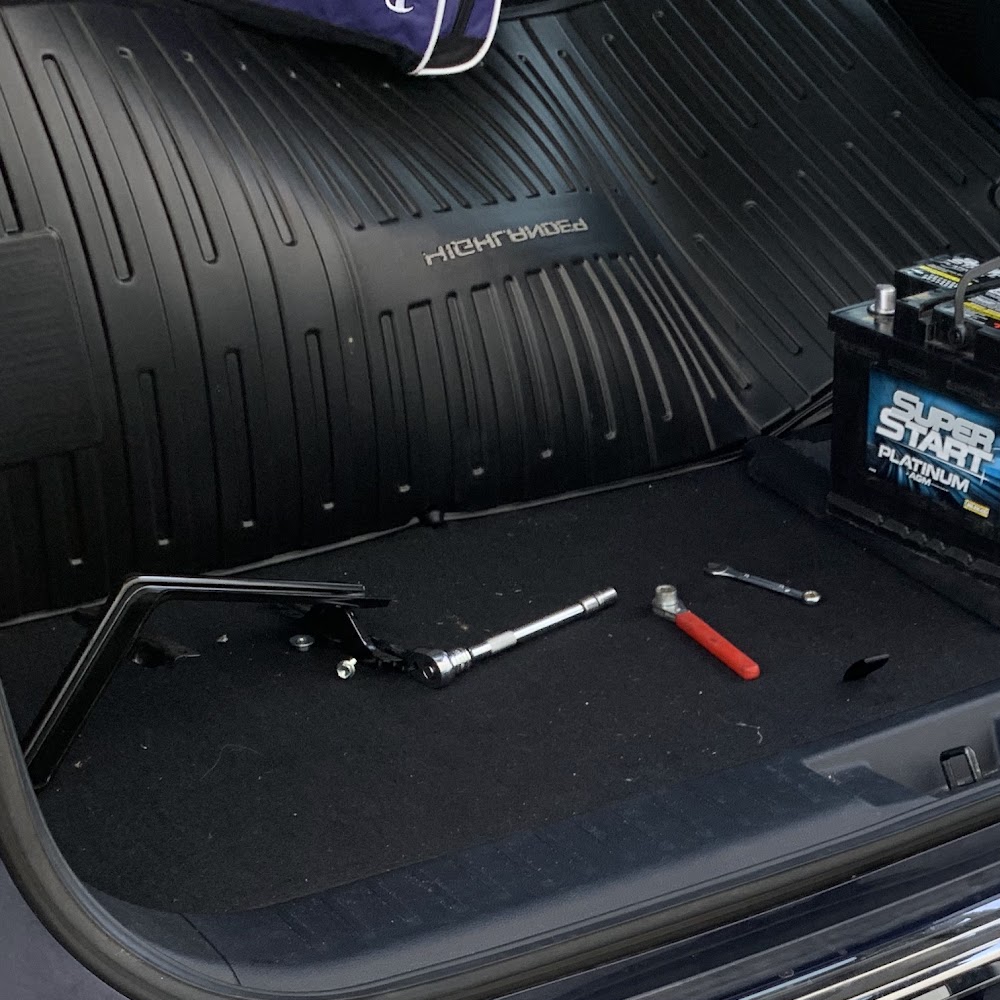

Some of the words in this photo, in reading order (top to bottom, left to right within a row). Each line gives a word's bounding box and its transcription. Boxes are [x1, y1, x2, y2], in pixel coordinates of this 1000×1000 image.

[875, 407, 995, 474] START
[893, 390, 996, 453] SUPER
[877, 444, 971, 493] PLATINUM
[908, 473, 933, 486] AGM
